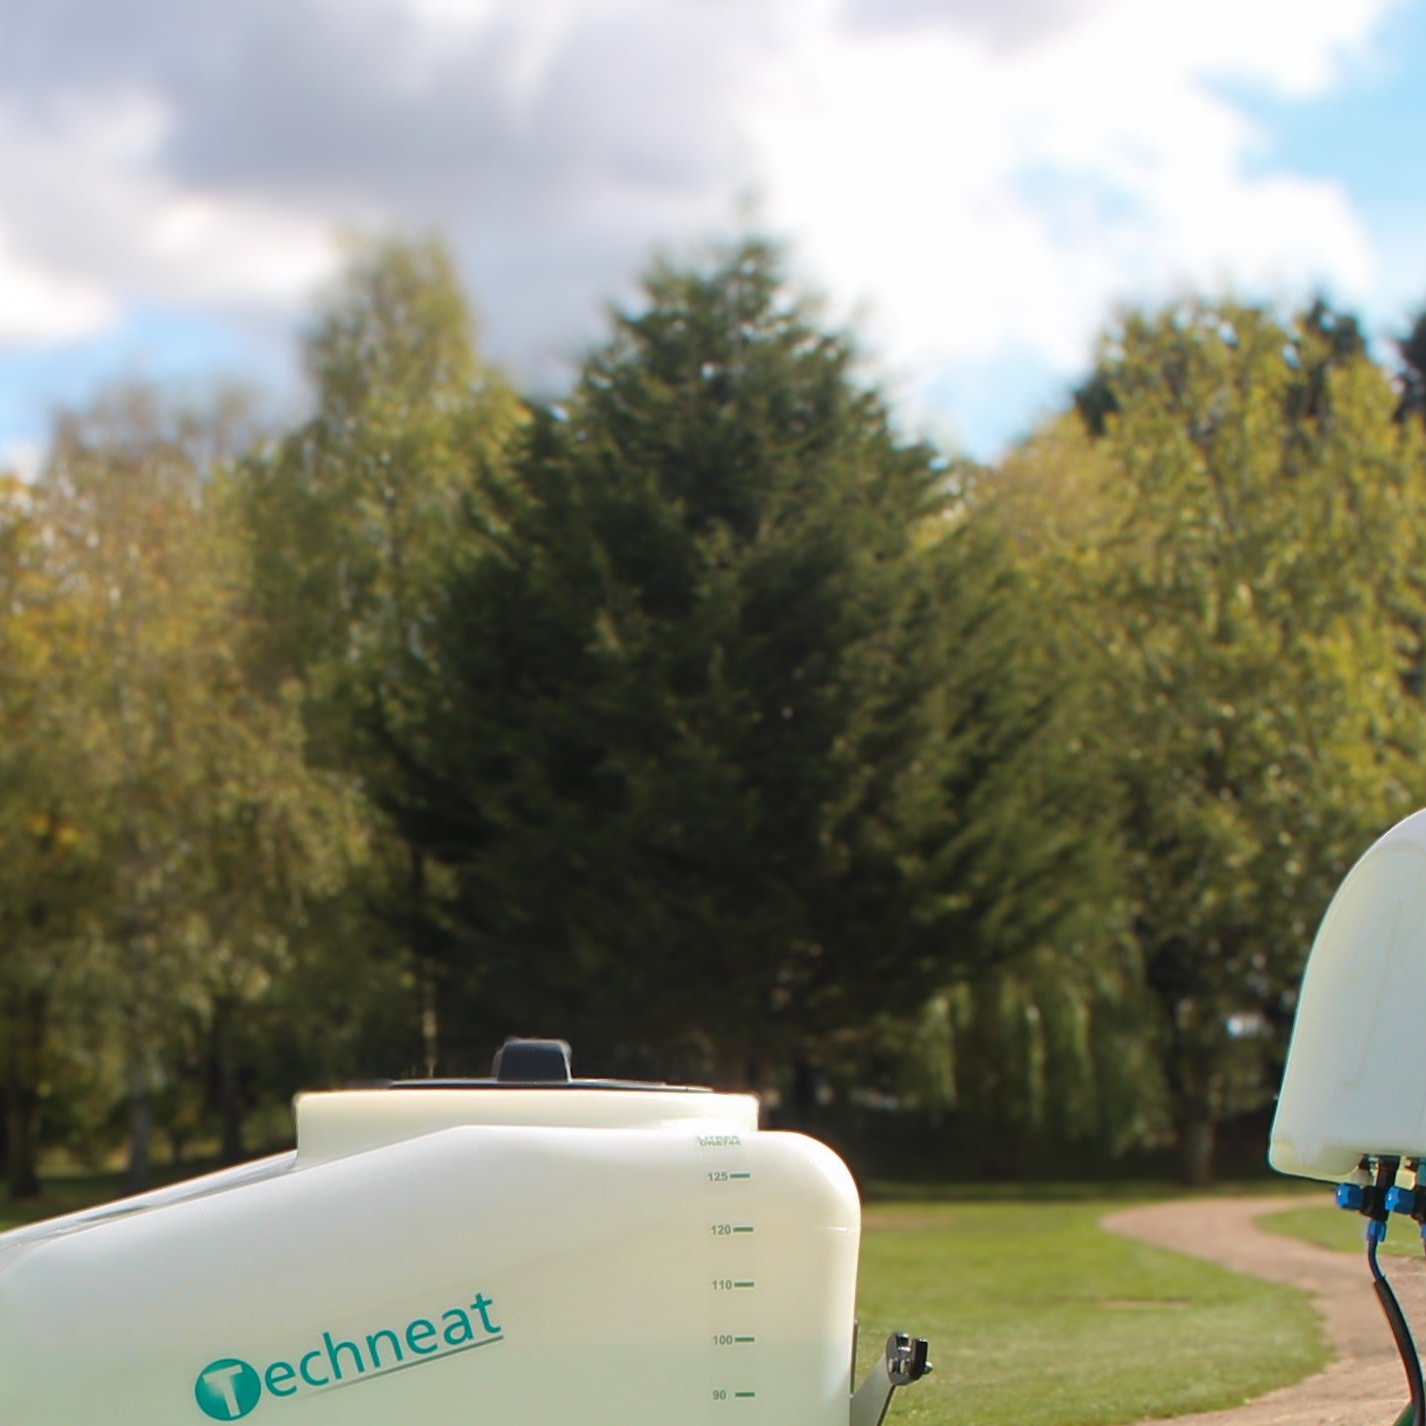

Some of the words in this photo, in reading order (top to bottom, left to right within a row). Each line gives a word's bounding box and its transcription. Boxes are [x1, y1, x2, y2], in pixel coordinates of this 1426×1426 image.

[707, 1171, 729, 1182] 125
[711, 1224, 732, 1236] 120
[712, 1279, 733, 1291] 110
[713, 1334, 733, 1346] 100
[195, 1292, 502, 1422] Techneat
[712, 1389, 727, 1401] 90
